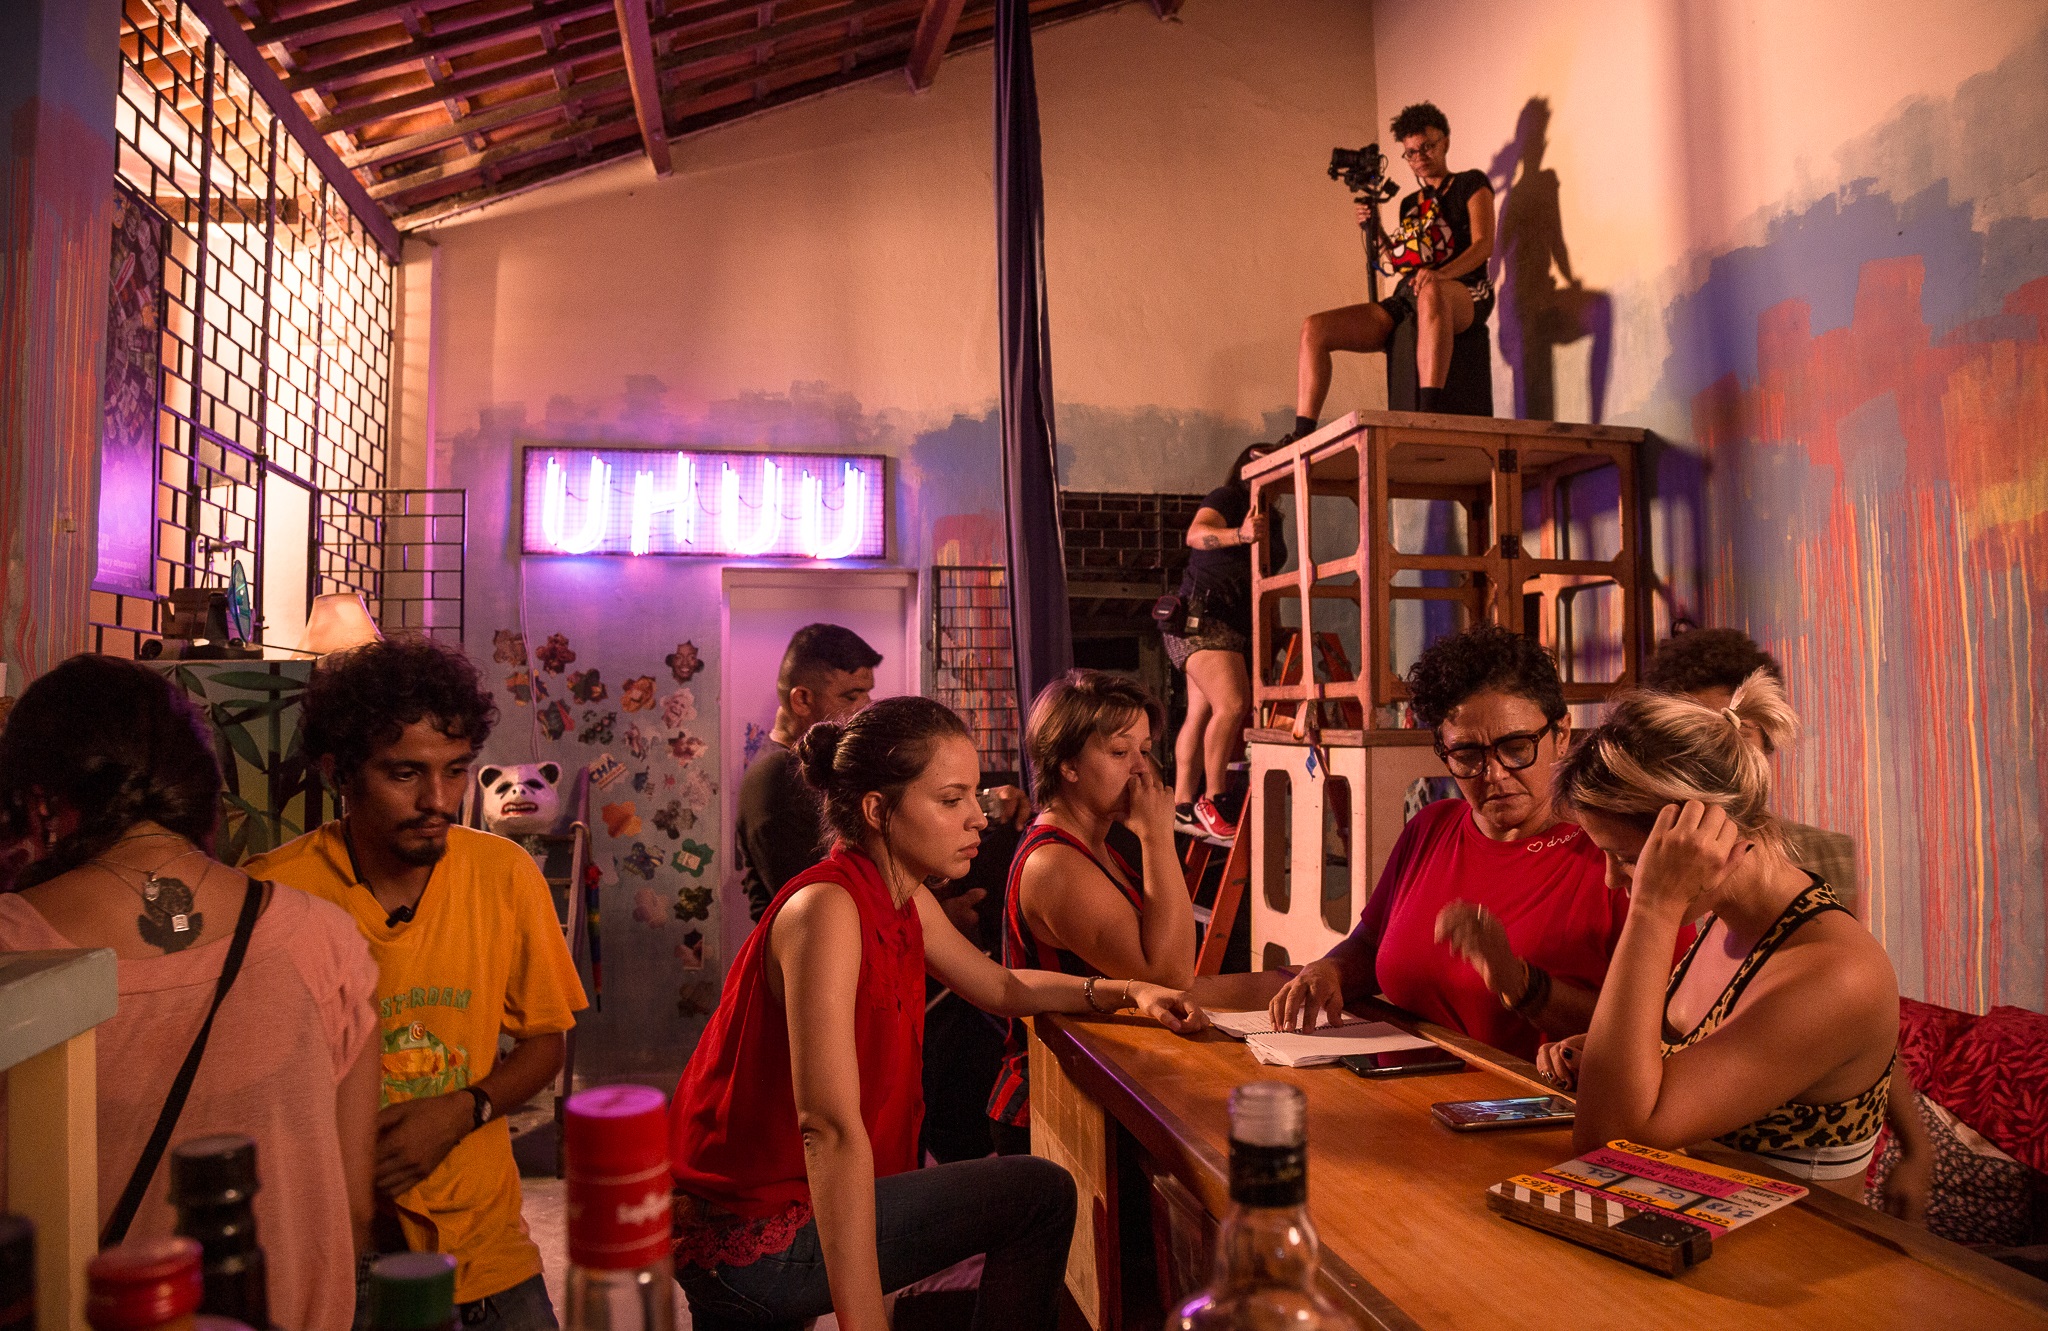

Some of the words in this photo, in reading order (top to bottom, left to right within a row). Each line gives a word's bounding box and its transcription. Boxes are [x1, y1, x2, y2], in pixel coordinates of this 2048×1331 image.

[542, 451, 867, 559] UHUU
[1546, 827, 1583, 848] drea
[1618, 1189, 1659, 1203] PLANO
[1696, 1211, 1731, 1225] CENA
